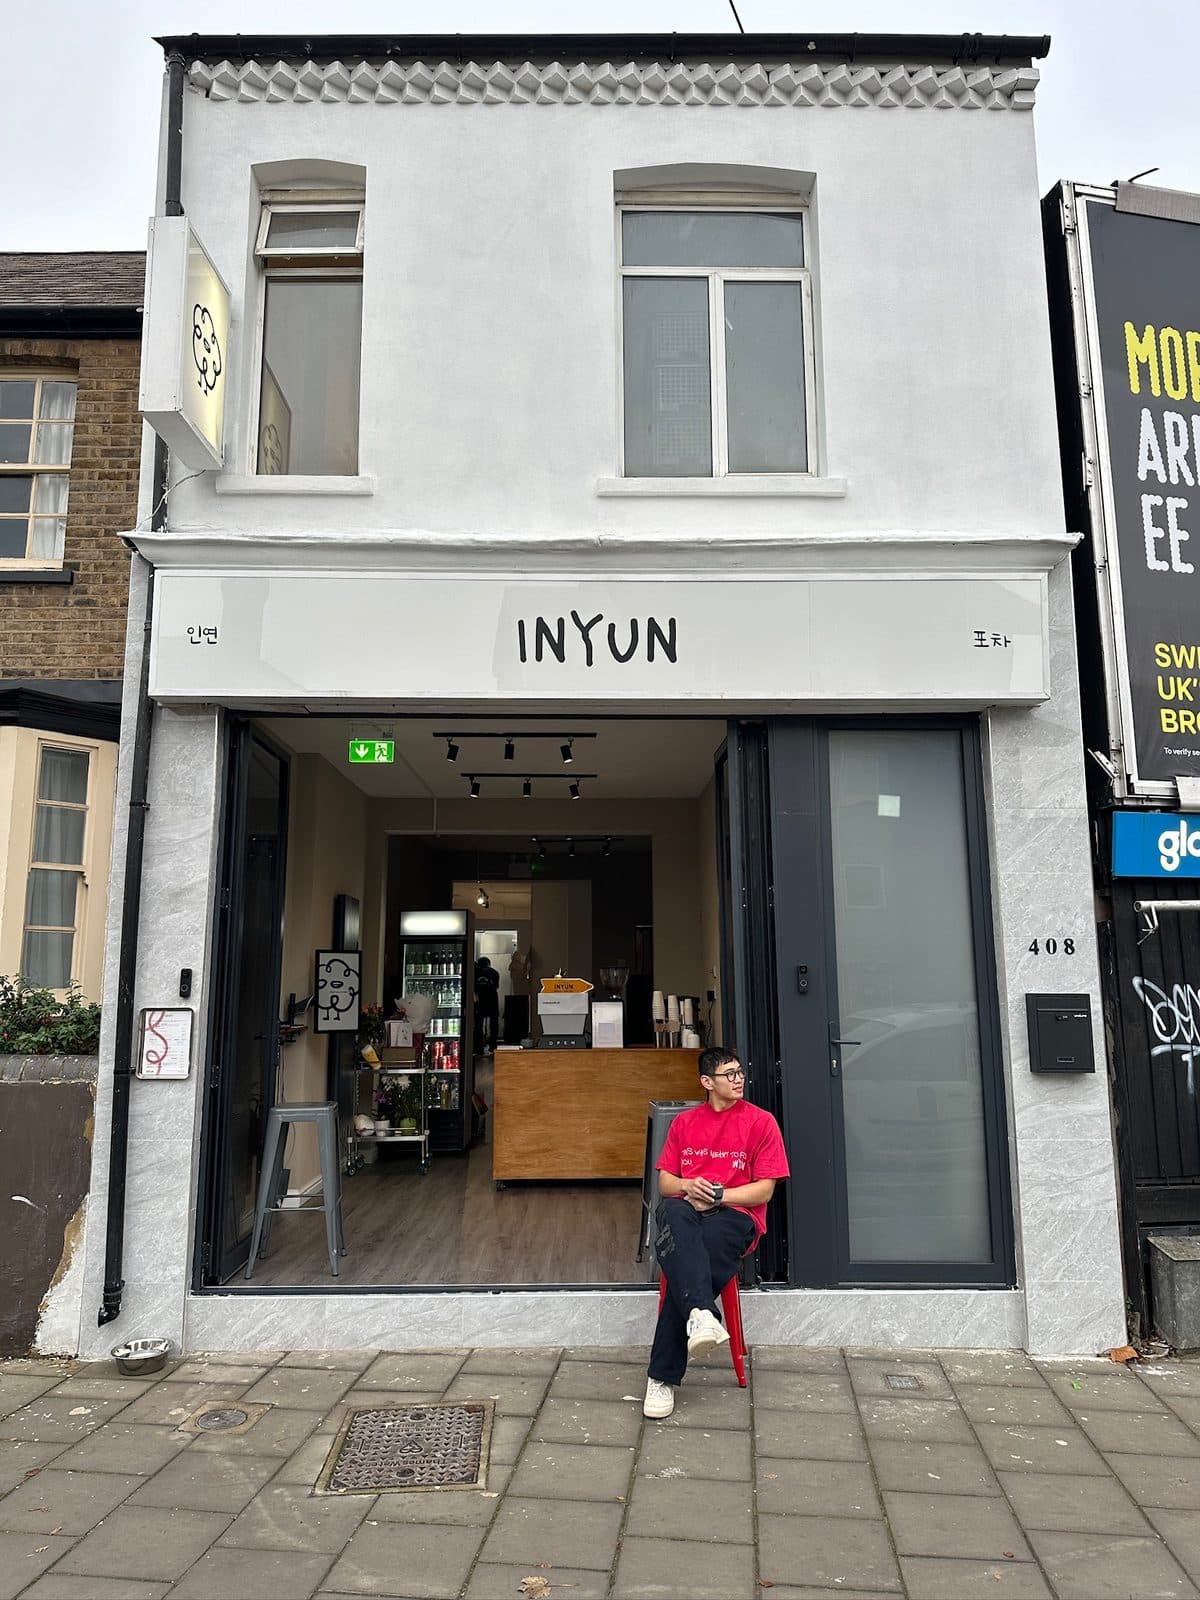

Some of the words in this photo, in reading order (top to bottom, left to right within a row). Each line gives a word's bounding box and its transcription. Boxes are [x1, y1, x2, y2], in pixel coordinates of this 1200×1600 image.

[1141, 493, 1194, 573] EE
[187, 625, 217, 644] 인연
[518, 610, 677, 667] INYUN
[973, 630, 1011, 647] 포차
[1154, 643, 1200, 669] SW
[1157, 676, 1200, 701] UK'
[1160, 708, 1200, 734] BR
[1163, 747, 1172, 755] To
[1173, 748, 1191, 757] verify
[1029, 938, 1075, 955] 408
